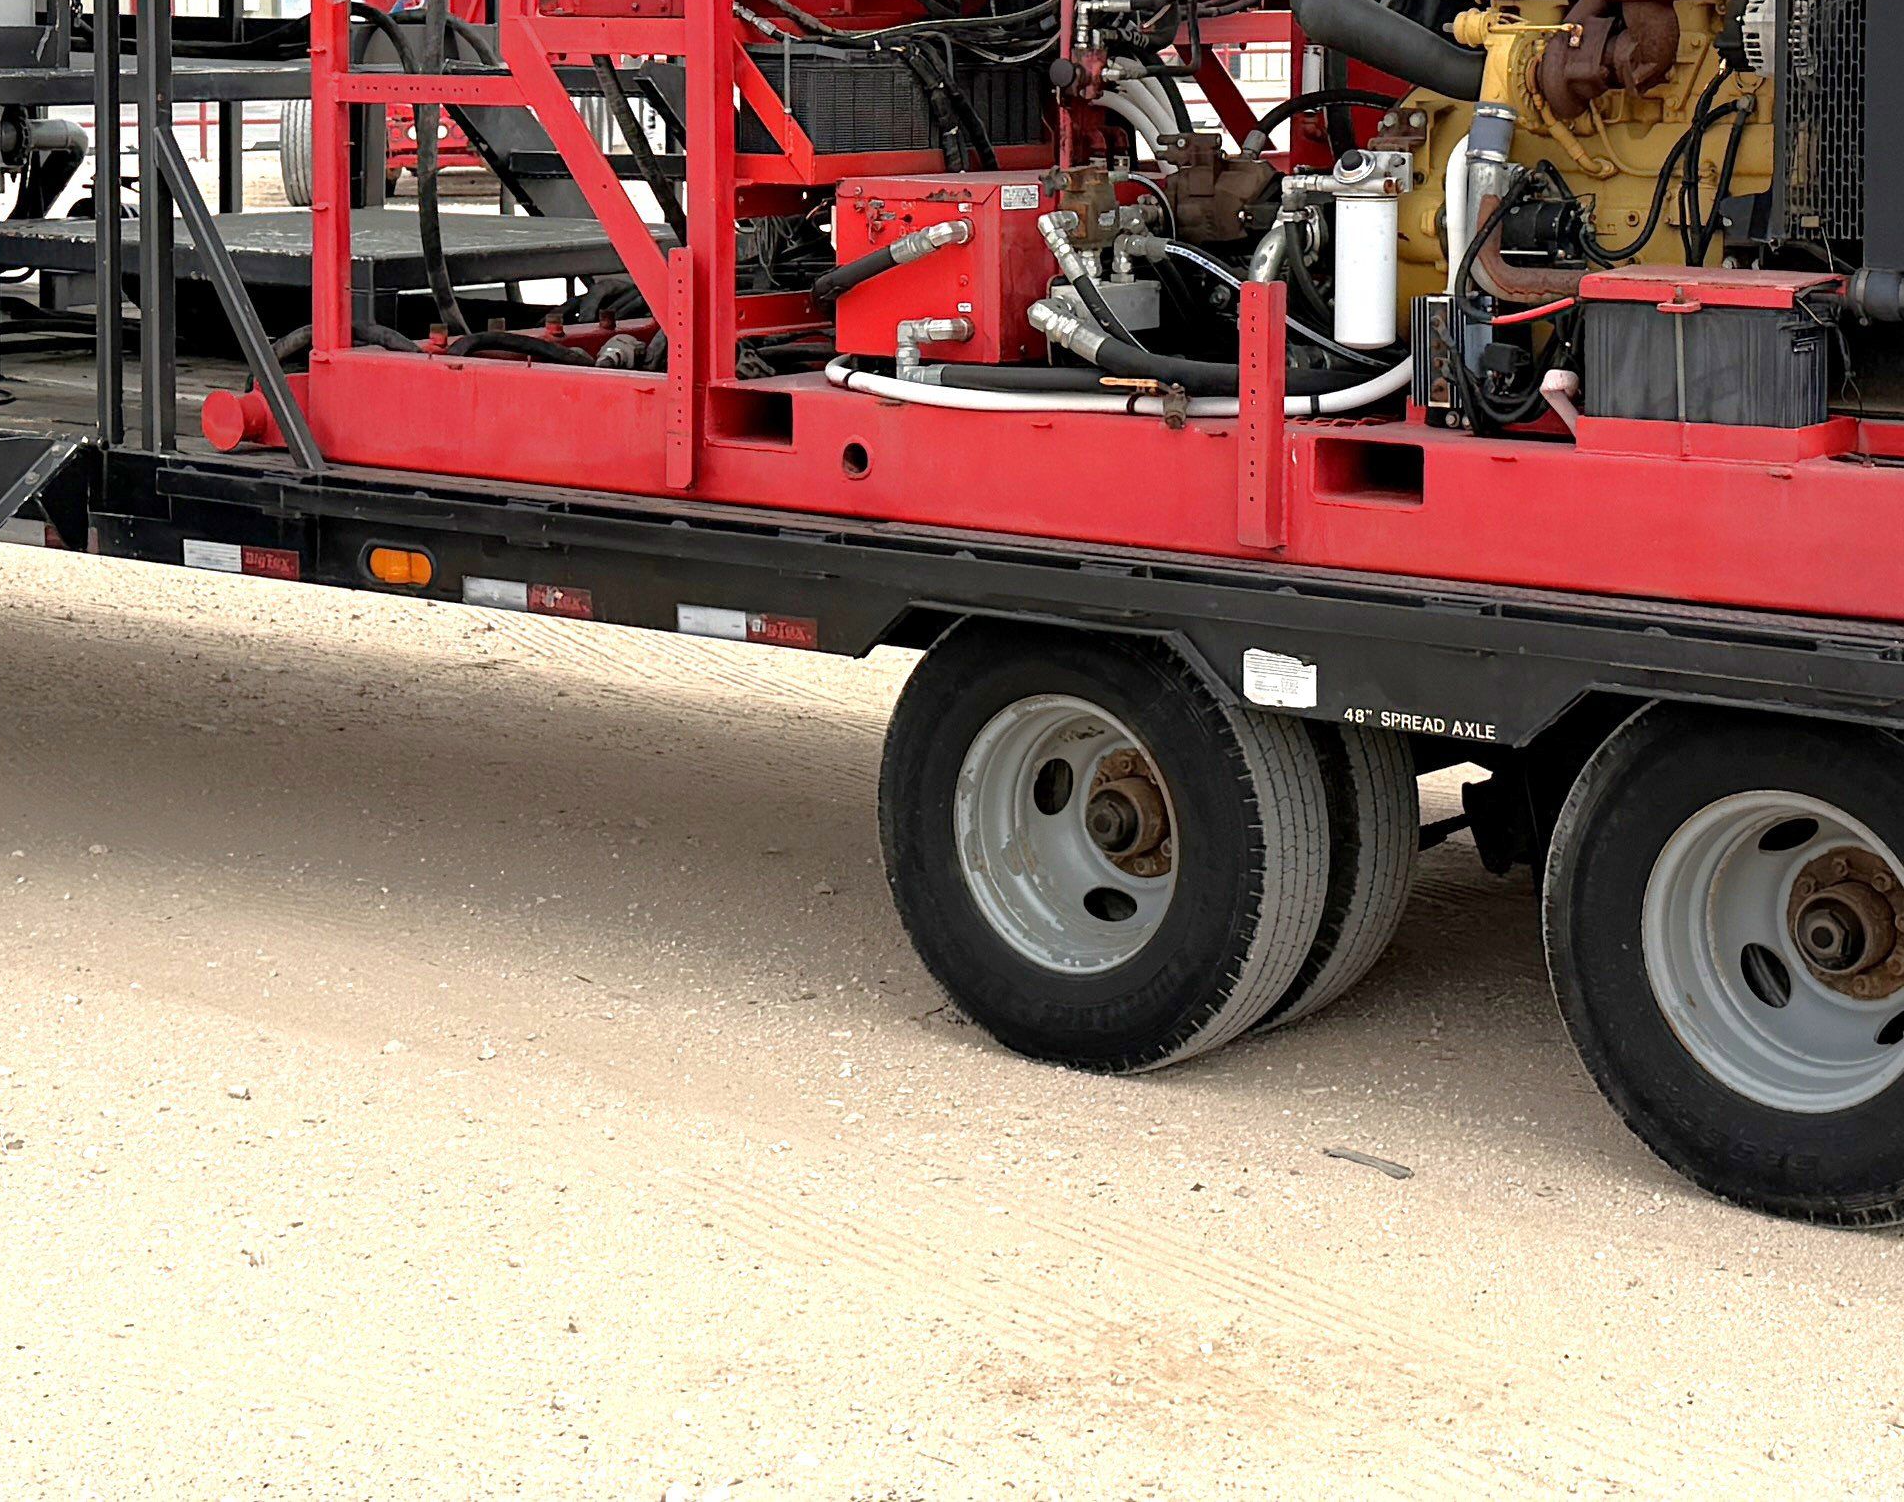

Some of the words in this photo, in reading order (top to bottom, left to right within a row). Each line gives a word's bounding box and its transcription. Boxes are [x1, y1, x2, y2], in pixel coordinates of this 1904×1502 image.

[1344, 707, 1373, 724] 48"
[1380, 711, 1446, 734] SPREAD
[1451, 720, 1496, 741] AXLE
